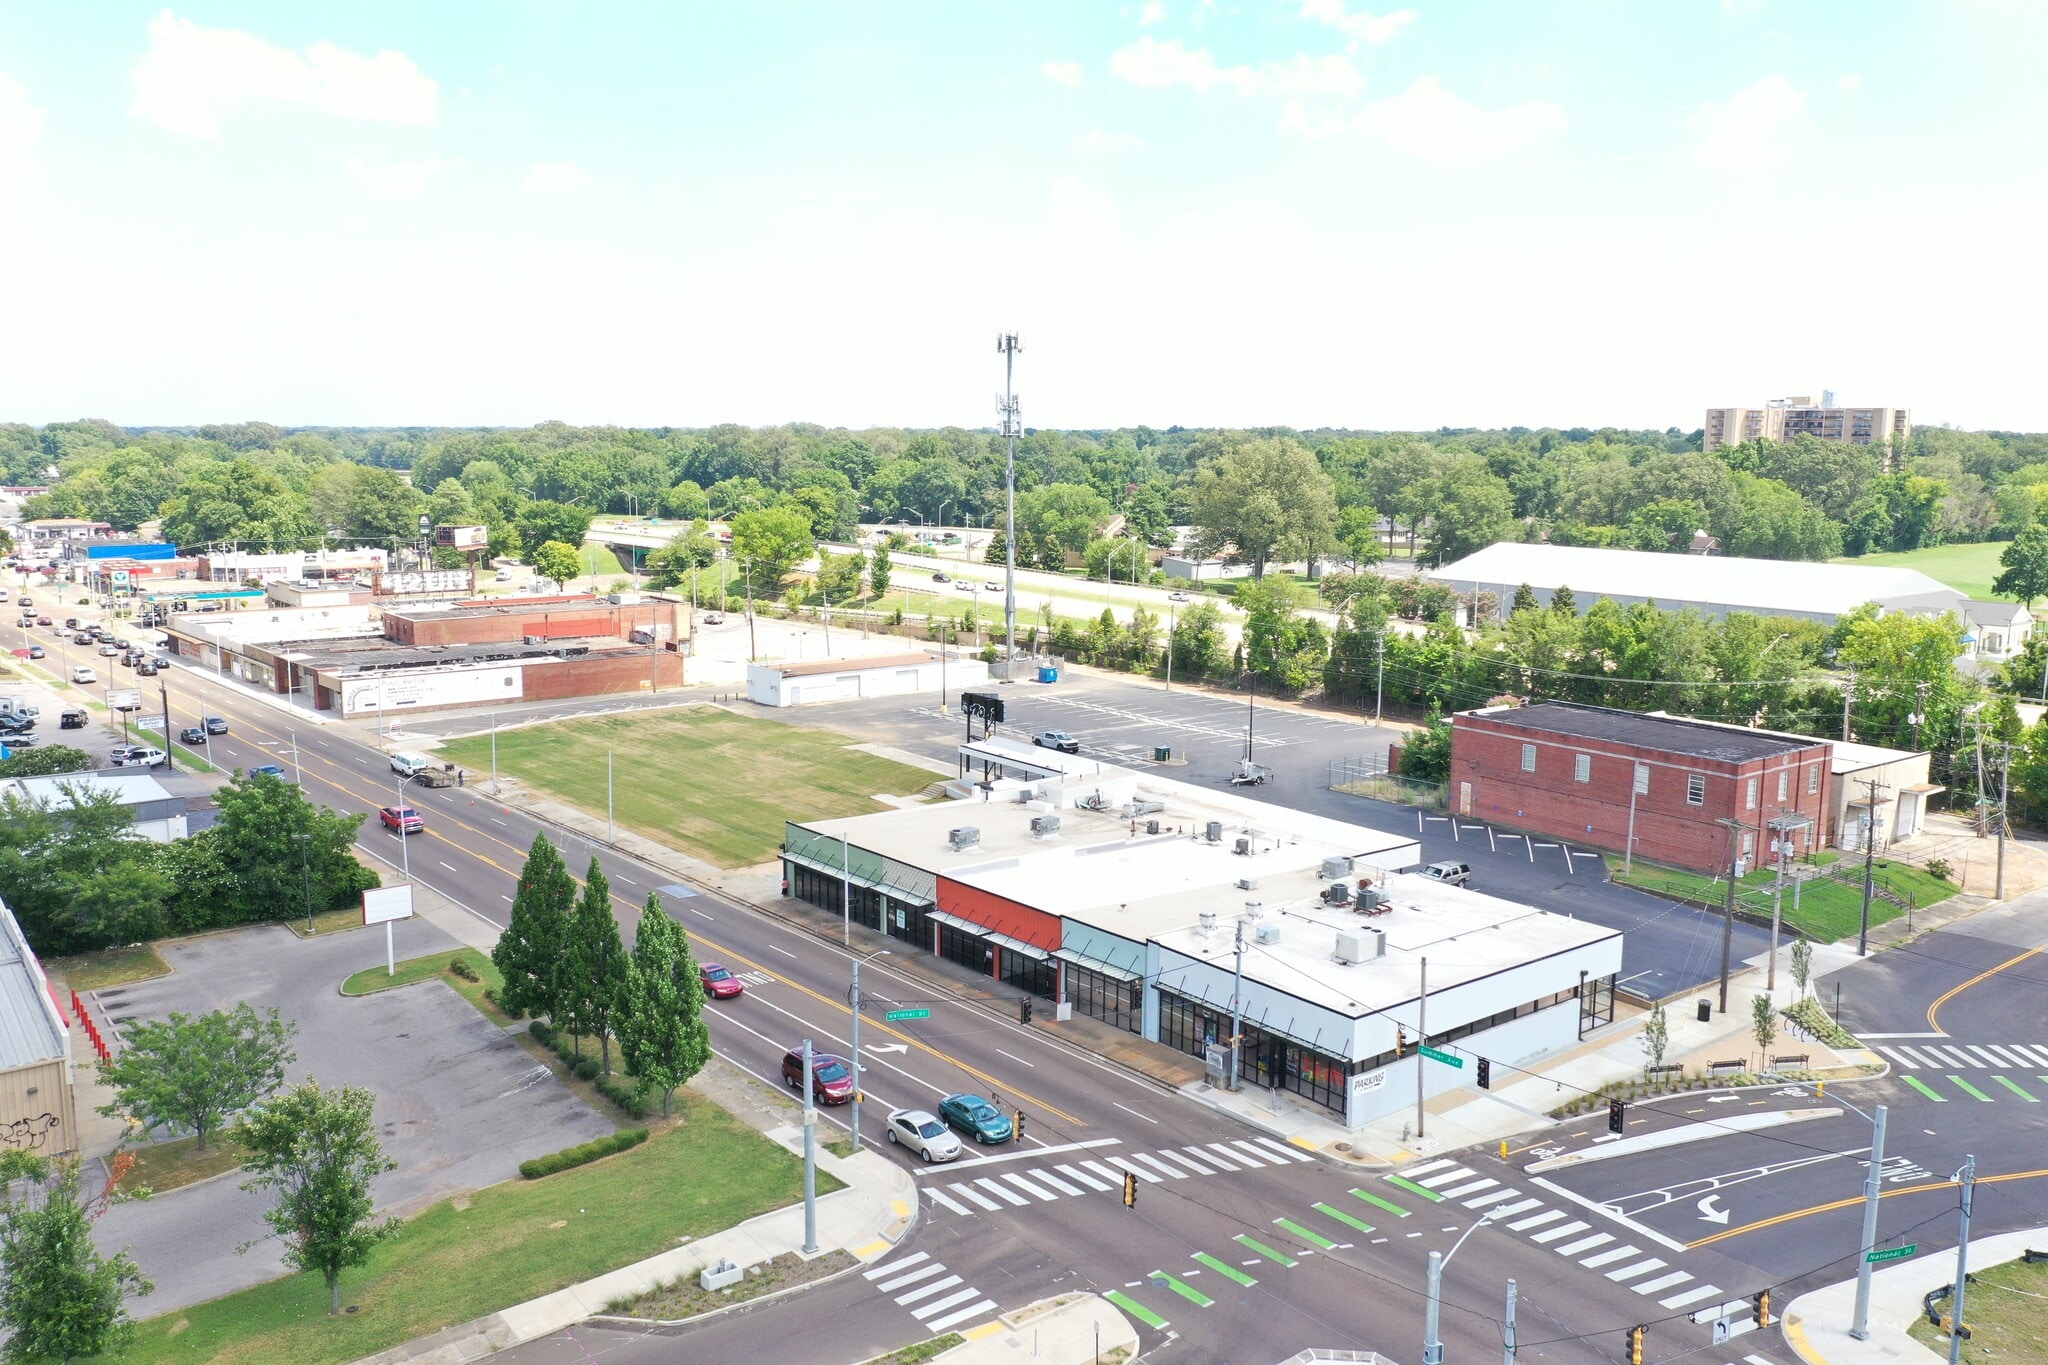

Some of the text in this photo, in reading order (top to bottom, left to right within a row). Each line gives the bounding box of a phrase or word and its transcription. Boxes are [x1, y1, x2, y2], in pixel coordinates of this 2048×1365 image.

[734, 971, 776, 988] ONLY
[888, 1011, 915, 1019] National
[1420, 1047, 1444, 1060] Summer
[1354, 1072, 1385, 1091] PARKING
[1869, 1250, 1901, 1260] National
[1714, 1334, 1728, 1343] ONLY
